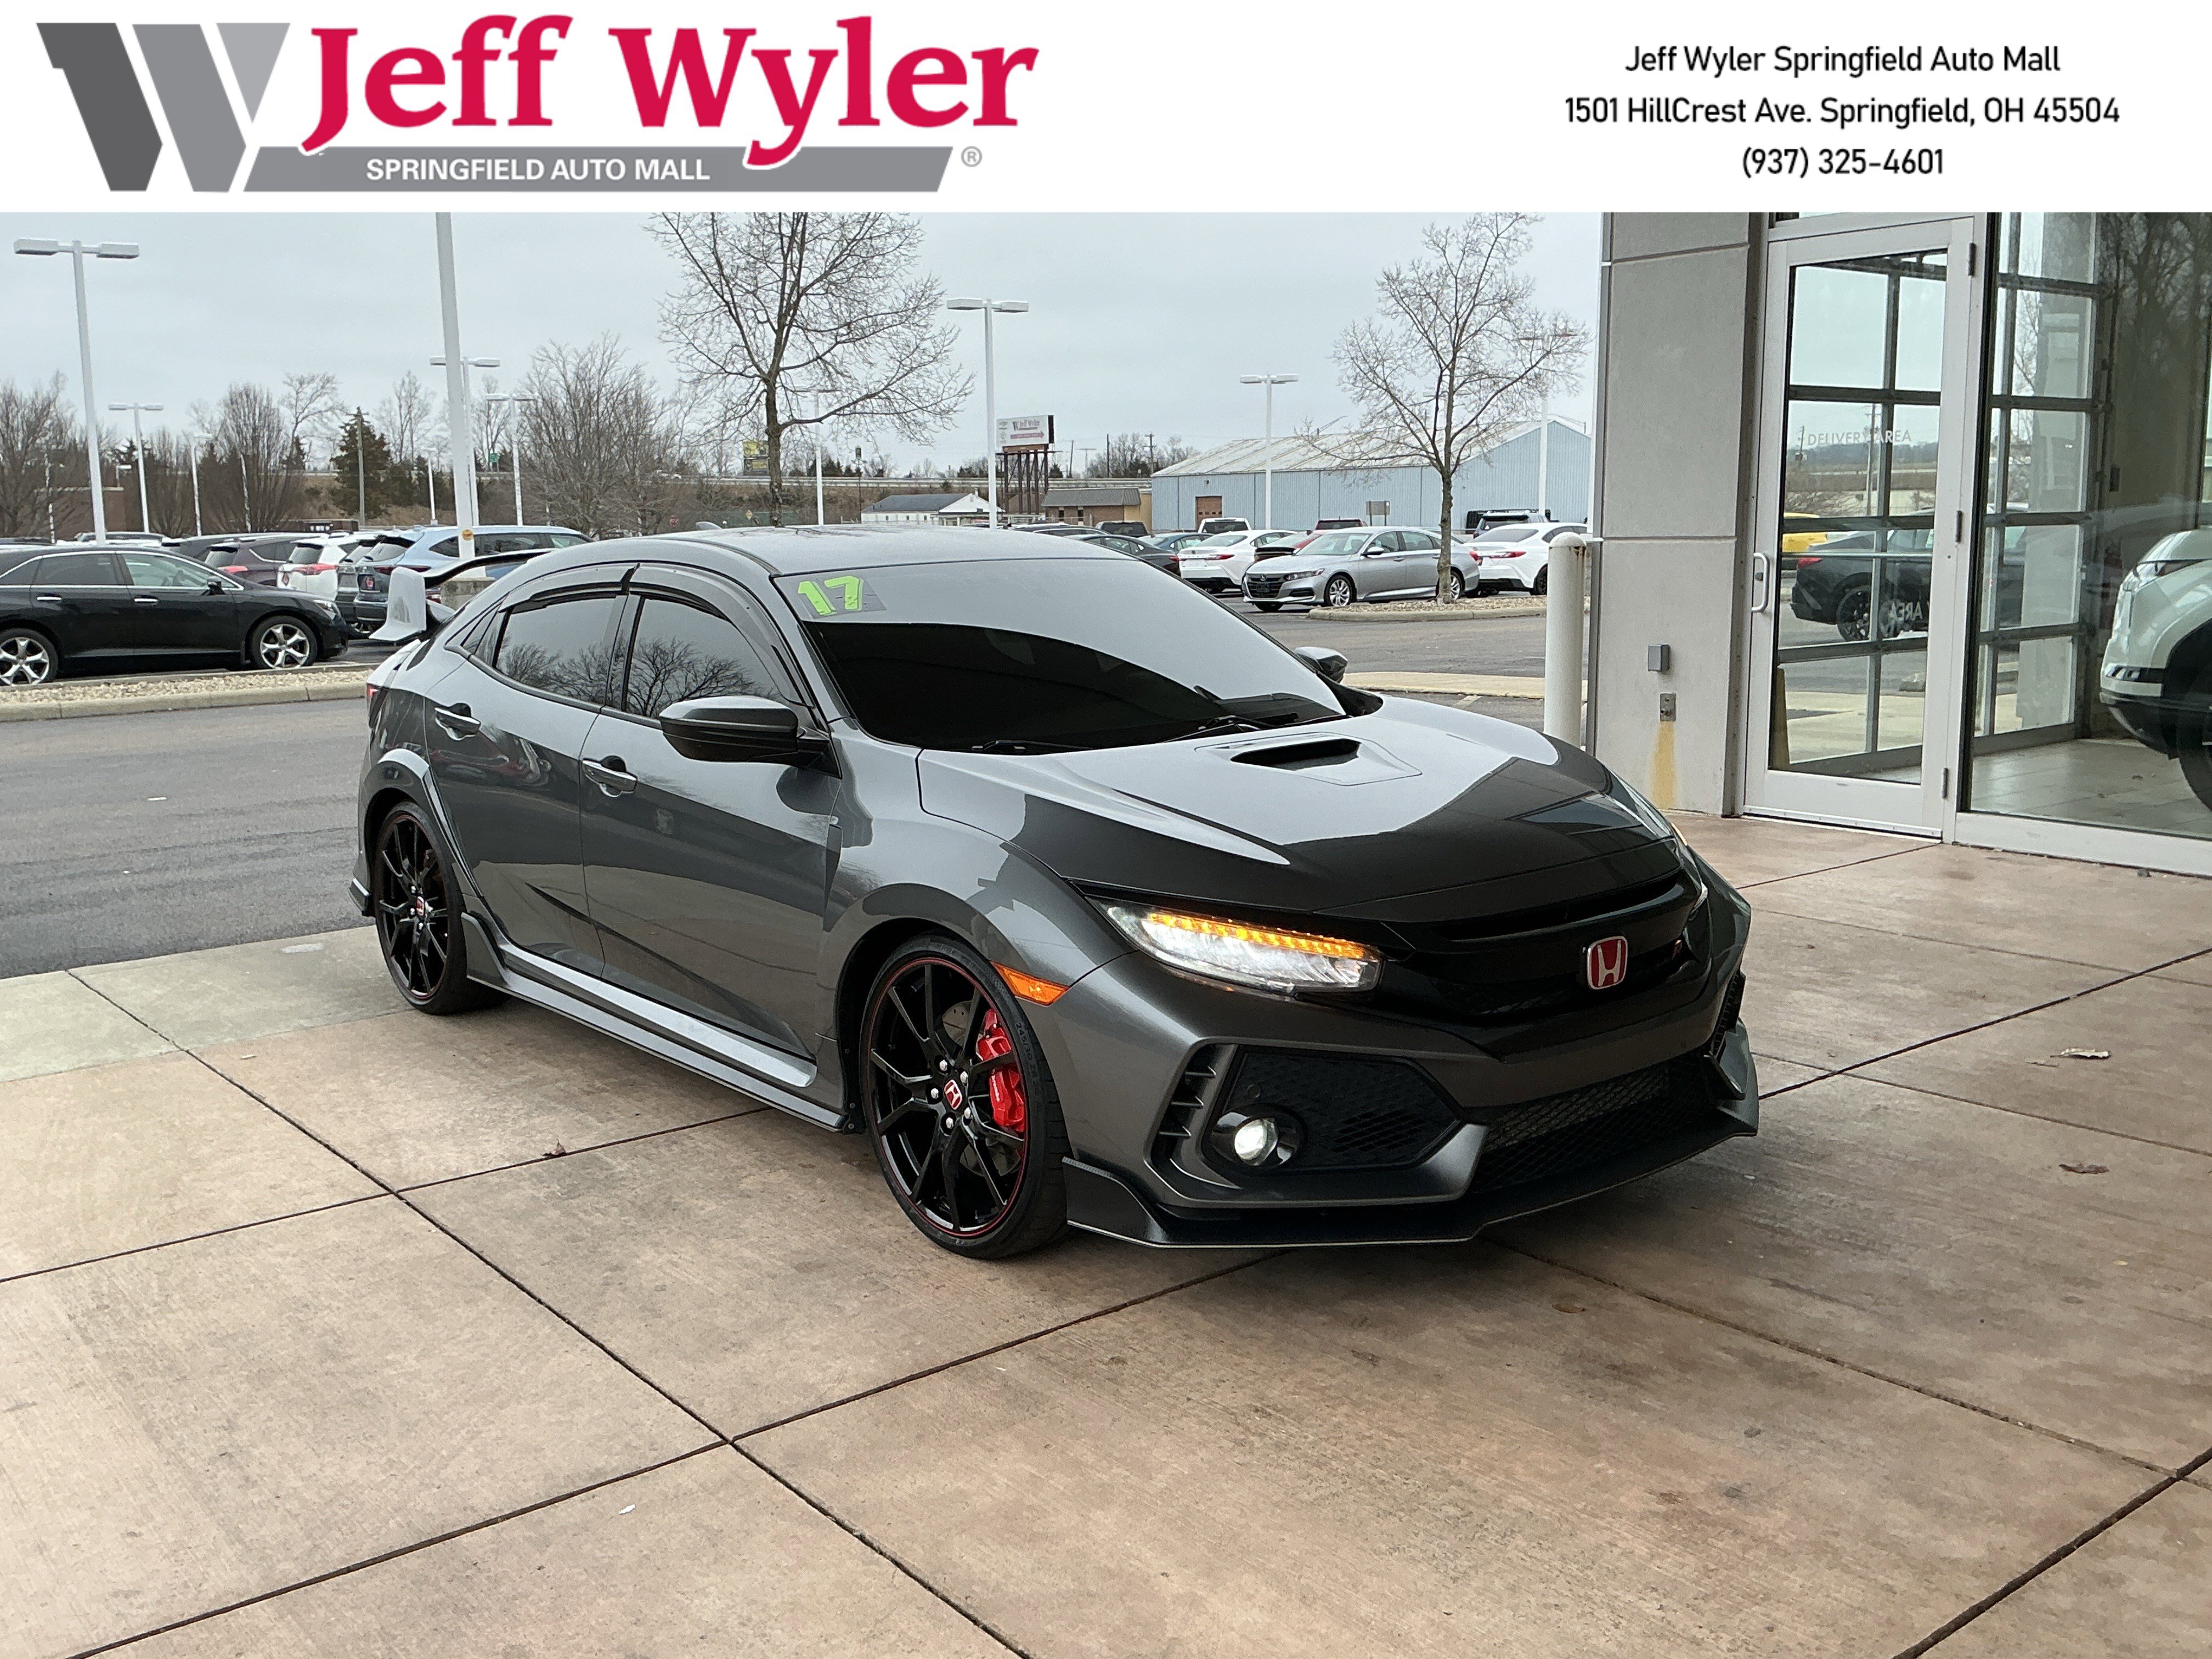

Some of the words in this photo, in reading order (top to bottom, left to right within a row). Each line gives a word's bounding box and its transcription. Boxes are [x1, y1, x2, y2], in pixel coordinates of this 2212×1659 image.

[1808, 432, 1870, 446] DELIVERY
[1874, 429, 1912, 443] AREA
[797, 575, 864, 616] 17
